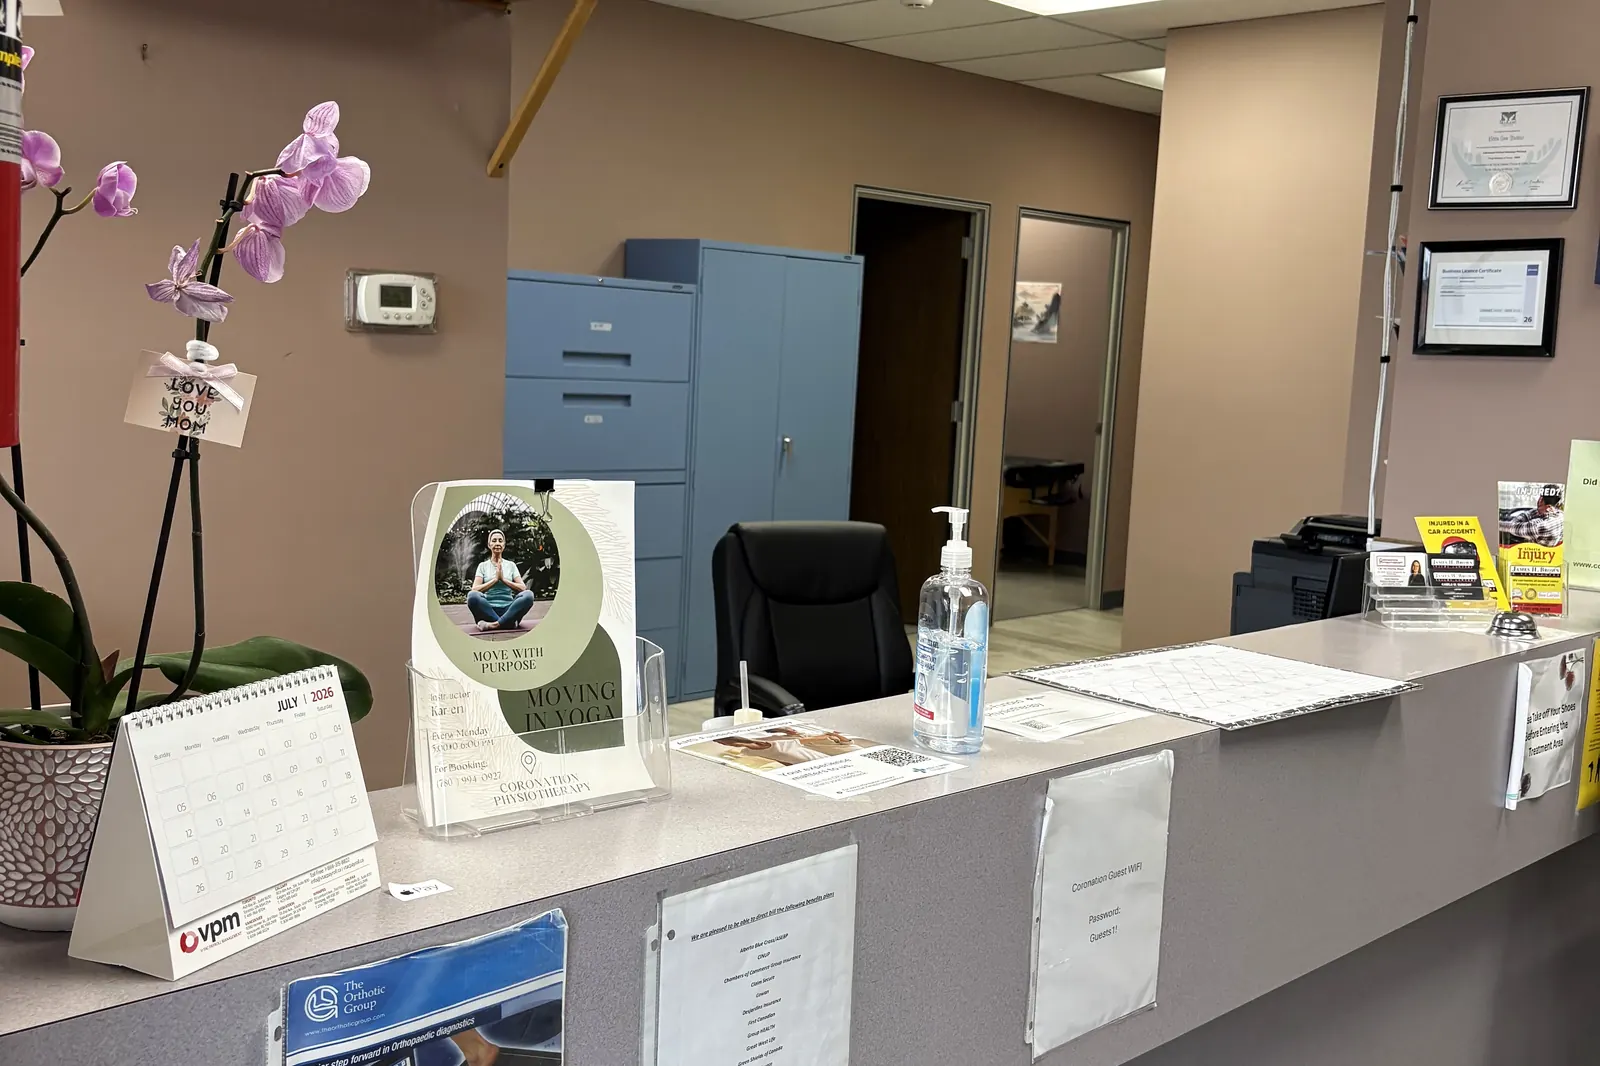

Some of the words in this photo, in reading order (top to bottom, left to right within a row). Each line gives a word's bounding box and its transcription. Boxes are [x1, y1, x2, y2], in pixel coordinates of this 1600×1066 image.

[171, 378, 215, 400] LOVE
[166, 415, 207, 434] MOM
[1583, 478, 1598, 486] Did
[1516, 487, 1561, 497] INJURED?
[1518, 548, 1556, 564] Injury
[473, 650, 509, 663] MOVE
[513, 647, 544, 659] WITH
[482, 660, 537, 674] PURPOSE
[278, 696, 298, 712] JULY
[311, 687, 334, 703] 2026
[527, 681, 616, 708] MOVING
[525, 712, 547, 732] IN
[556, 705, 615, 727] YOGA
[1532, 711, 1542, 722] Take
[1542, 708, 1551, 719] off
[1550, 707, 1560, 717] Your
[1561, 703, 1576, 714] Shoes
[1540, 723, 1560, 737] Entering
[1560, 720, 1568, 730] the
[154, 751, 171, 761] Sunday
[184, 742, 202, 751] Monday
[212, 734, 230, 743] Tuesday
[238, 725, 260, 736] Wednesday
[266, 718, 284, 727] Thursday
[258, 748, 266, 757] 01
[309, 732, 318, 740] 03
[333, 724, 342, 733] 04
[1529, 741, 1553, 757] Treatment
[1553, 739, 1564, 749] Area
[434, 766, 447, 774] For
[177, 803, 187, 813] 05
[207, 792, 217, 802] 06
[236, 783, 245, 792] 07
[263, 774, 272, 783] 08
[289, 765, 298, 774] 09
[316, 756, 323, 764] 10
[500, 773, 580, 794] CORONATION
[494, 782, 591, 806] PHYSIOTHERAPY
[185, 829, 193, 838] 12
[216, 818, 223, 827] 13
[243, 808, 251, 817] 14
[271, 798, 278, 807] 15
[297, 789, 304, 798] 16
[322, 780, 328, 788] 17
[345, 771, 352, 780] 18
[191, 856, 199, 866] 19
[220, 845, 229, 854] 20
[250, 834, 257, 843] 21
[276, 824, 283, 833] 22
[302, 814, 309, 823] 23
[326, 805, 333, 814] 24
[350, 795, 358, 804] 25
[196, 883, 205, 894] 26
[226, 871, 234, 881] 27
[254, 859, 262, 869] 28
[280, 849, 289, 858] 29
[306, 838, 314, 848] 30
[333, 828, 339, 837] 31
[1072, 874, 1108, 893] Coronation
[1108, 868, 1128, 880] Guest
[1089, 906, 1121, 924] Password:
[198, 912, 240, 942] vpm
[1090, 925, 1118, 943] Guests1!
[344, 980, 364, 992] The
[724, 974, 744, 984] Chambers
[751, 980, 762, 988] Claim
[344, 986, 386, 1003] Orthotic
[344, 1000, 377, 1014] Group
[304, 1013, 386, 1036] www.theorthoticgroup.com
[351, 1047, 381, 1064] forward
[382, 1046, 390, 1054] in
[392, 1031, 436, 1052] Orthopaedic
[436, 1017, 475, 1037] diagnostics
